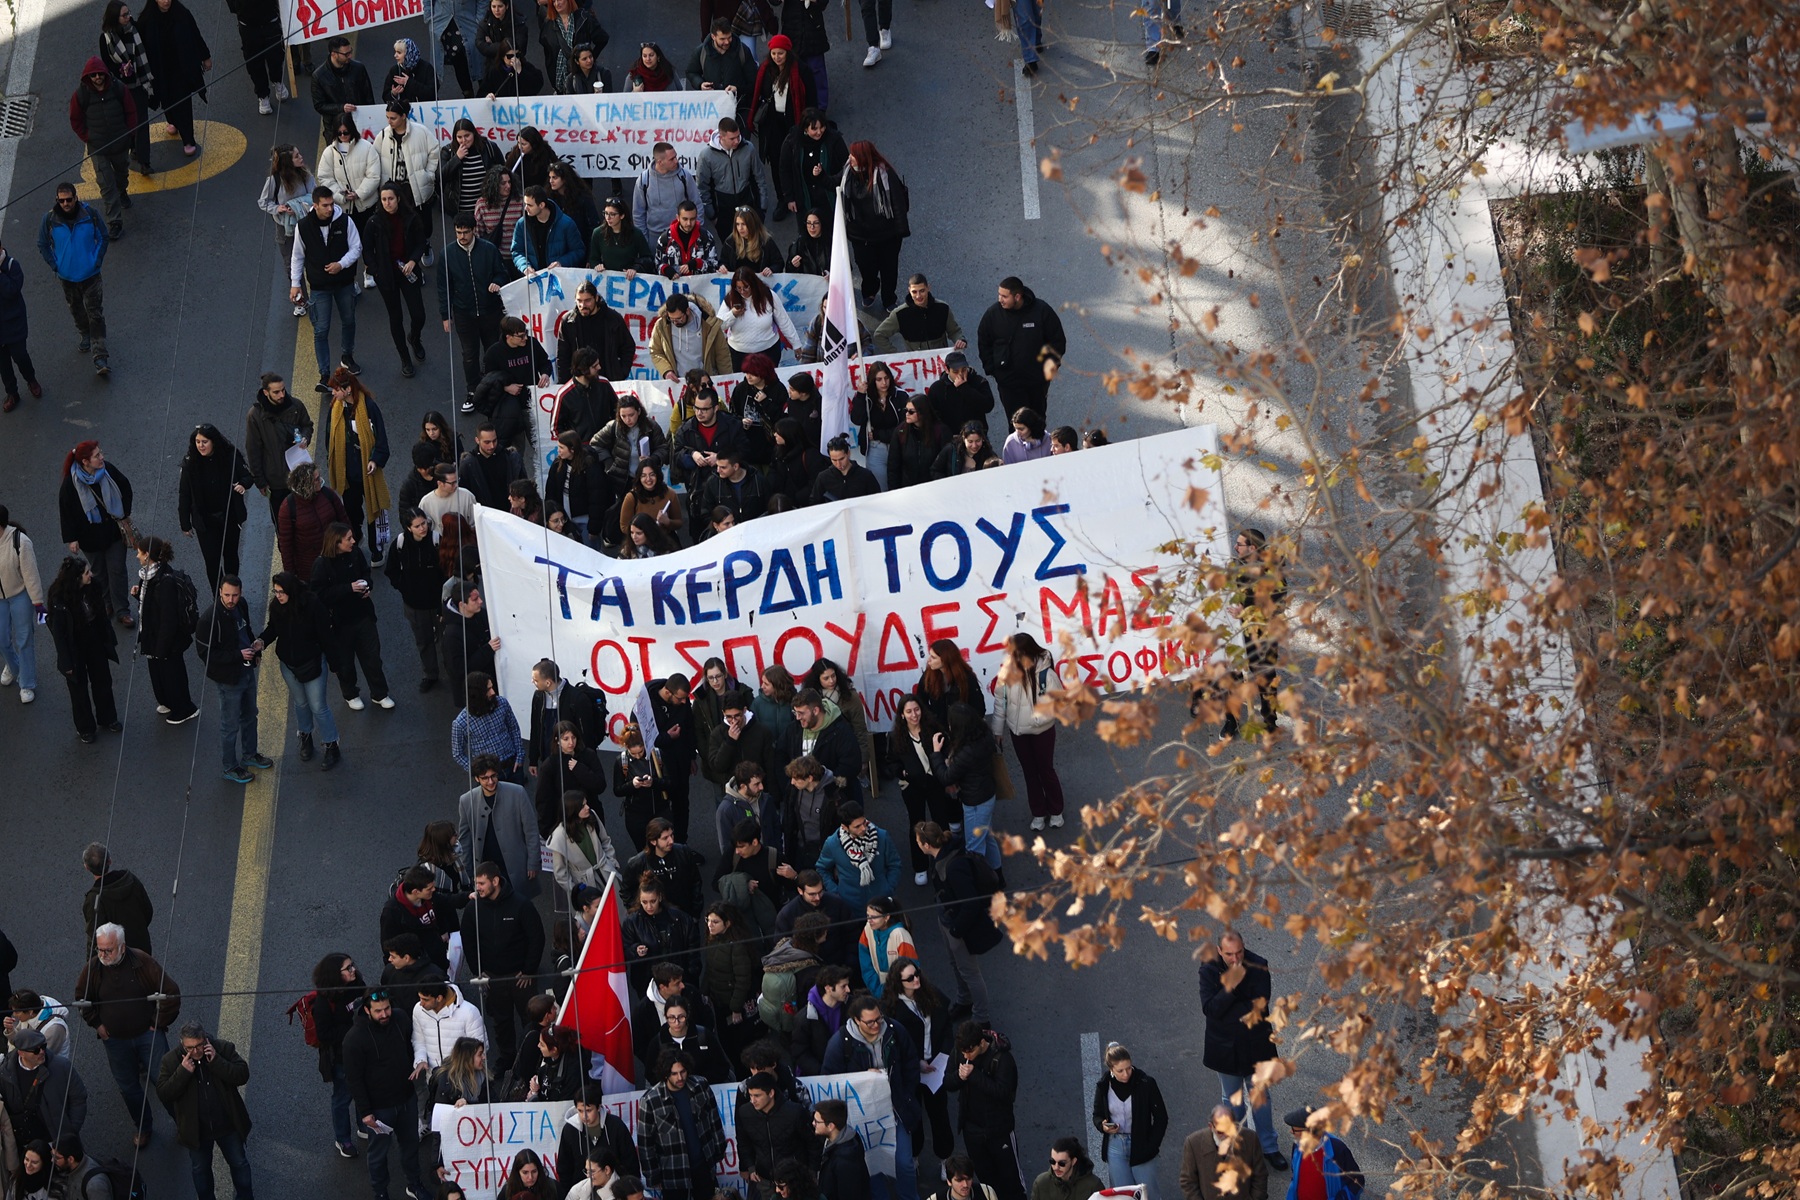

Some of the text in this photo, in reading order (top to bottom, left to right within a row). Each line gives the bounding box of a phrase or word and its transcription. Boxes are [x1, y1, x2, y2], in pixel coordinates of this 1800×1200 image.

[431, 105, 474, 126] ΣΤΑ
[491, 102, 582, 127] ΙΔΙΩΤΙΚΑ
[595, 101, 720, 124] ΠΑΝΕΠΙΣΤΗΜΙΑ
[554, 128, 600, 145] ΖΩΕΣ
[653, 128, 714, 143] ΣΠΟΥΔΕ
[528, 271, 565, 306] ΤΑ
[534, 503, 1087, 627] ΤΑ ΚΕΡΔΗ ΤΟΥΣ
[674, 592, 1009, 702] ΣΠΟΥΔΕΣ
[1039, 564, 1173, 644] ΜΑΣ
[457, 1109, 557, 1147] ΟΧΙ ΣΤΑ
